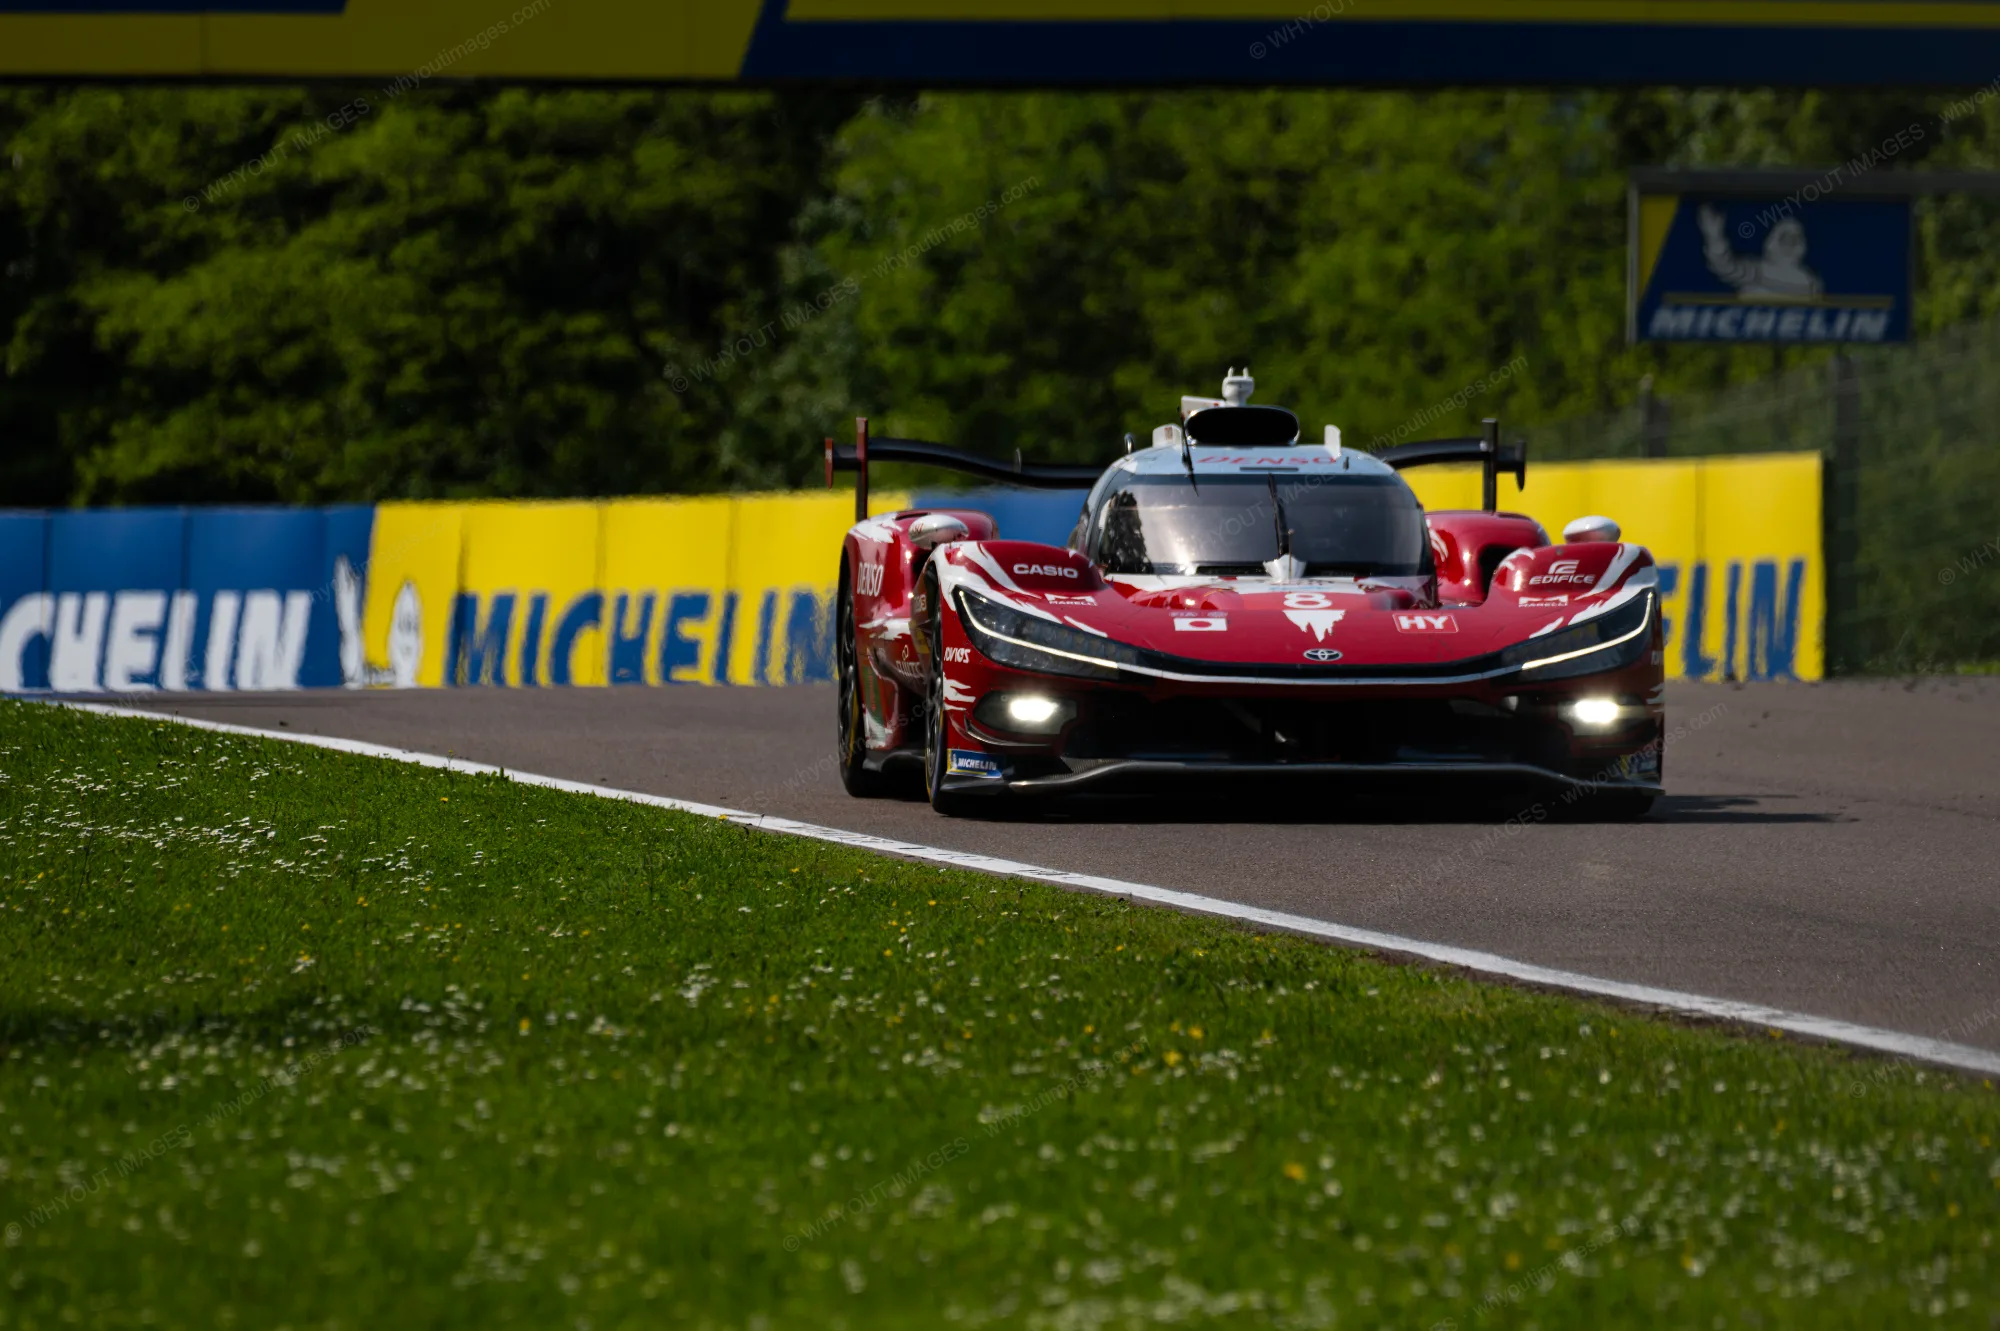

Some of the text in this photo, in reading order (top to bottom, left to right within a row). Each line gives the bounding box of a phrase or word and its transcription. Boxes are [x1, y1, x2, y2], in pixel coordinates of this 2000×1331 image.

[1650, 308, 1888, 340] MICHELIN
[1196, 455, 1337, 465] DENSO
[856, 561, 884, 597] DENSO
[1013, 563, 1078, 579] CASIO
[1529, 574, 1596, 584] EDIFICE
[1284, 592, 1332, 609] 8
[1398, 616, 1449, 630] HY
[446, 588, 838, 687] MICHELIN
[958, 758, 997, 770] MICHELIN
